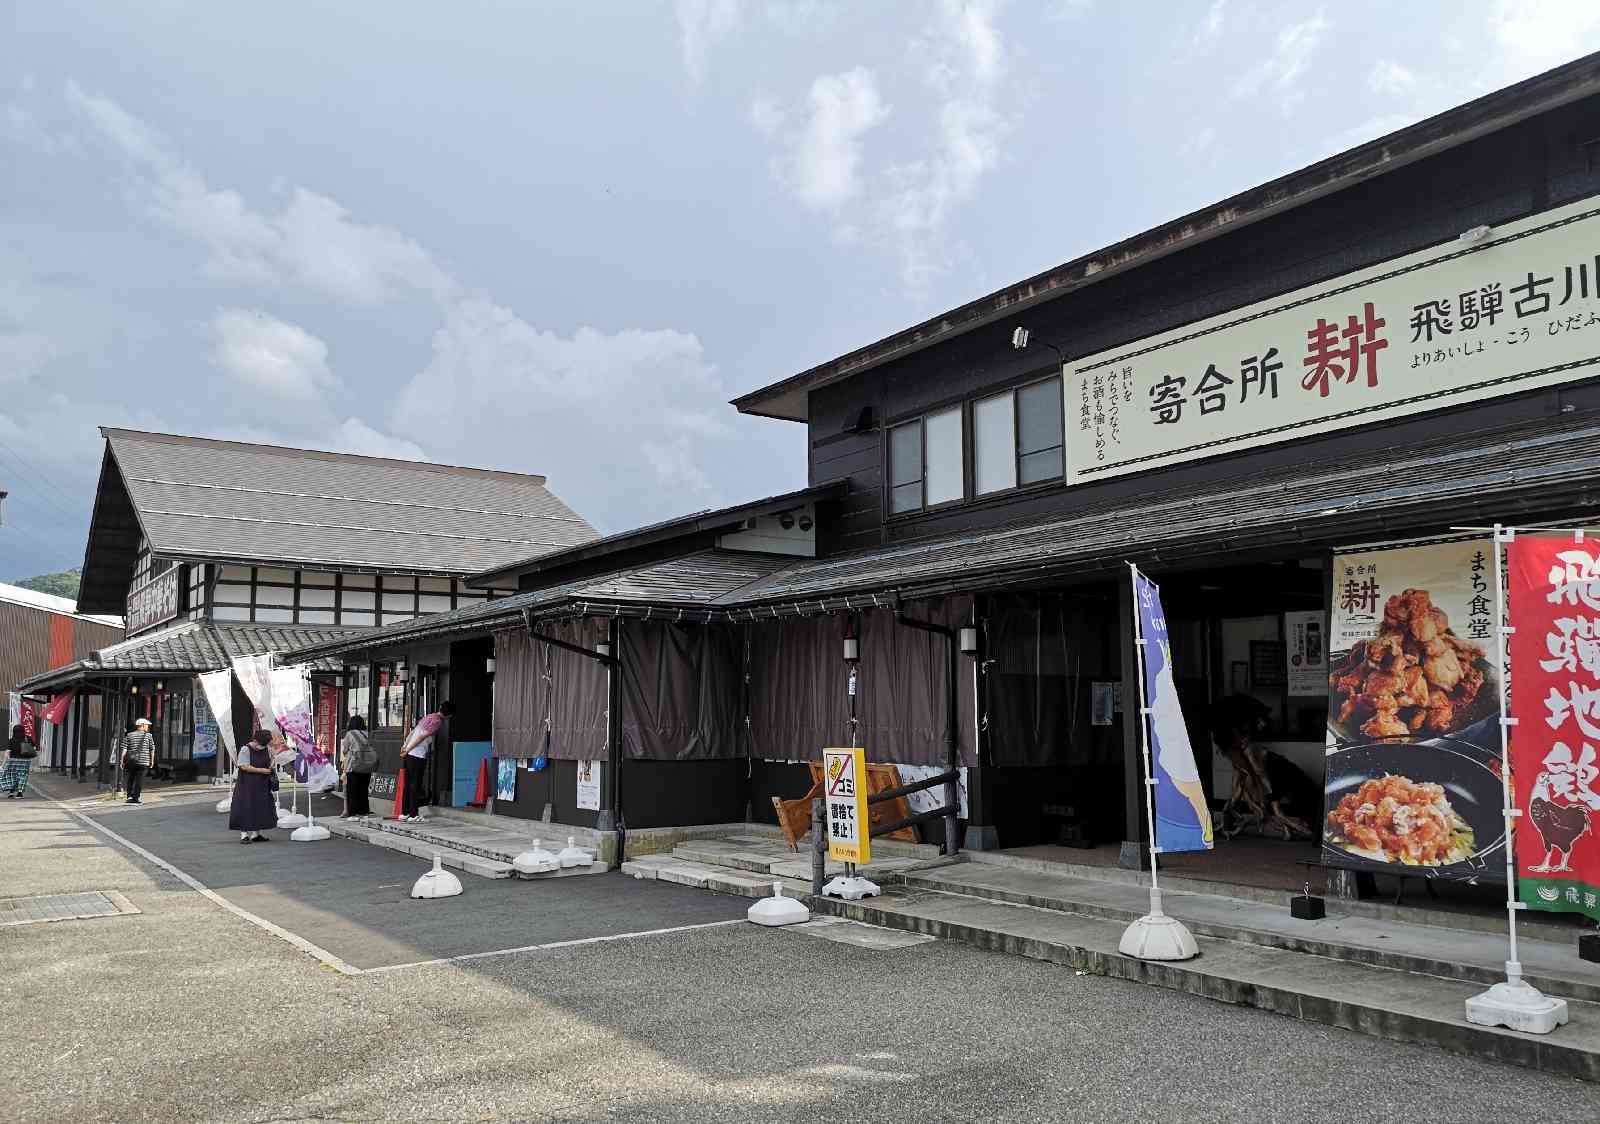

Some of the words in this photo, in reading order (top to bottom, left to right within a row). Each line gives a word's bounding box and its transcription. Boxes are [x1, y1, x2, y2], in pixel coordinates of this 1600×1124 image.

[1149, 347, 1283, 424] 寄合所
[1300, 302, 1388, 397] 耕
[1341, 576, 1381, 614] 耕
[1467, 551, 1491, 639] まち食堂
[838, 778, 854, 794] ゴミ
